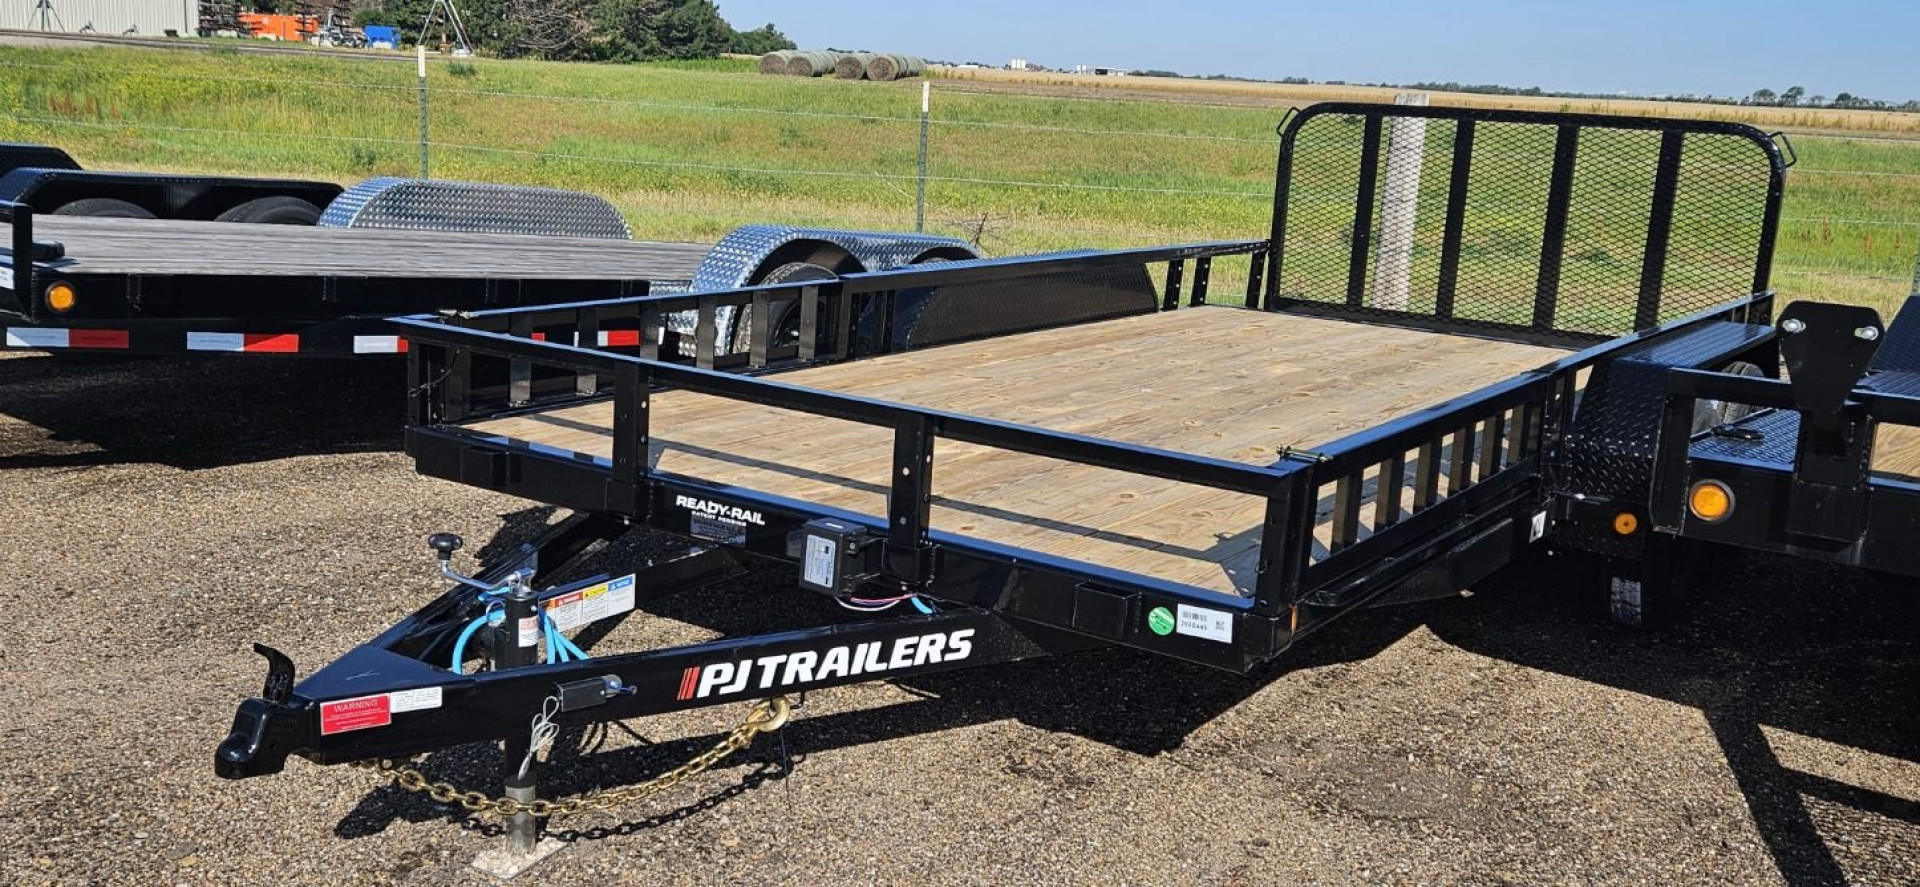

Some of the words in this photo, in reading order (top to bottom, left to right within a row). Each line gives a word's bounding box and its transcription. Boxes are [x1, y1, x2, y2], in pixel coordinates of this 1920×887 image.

[676, 495, 765, 526] READY-RAIL
[696, 659, 753, 698] PJ
[757, 629, 975, 689] TRAILERS
[333, 699, 378, 713] WARNING
